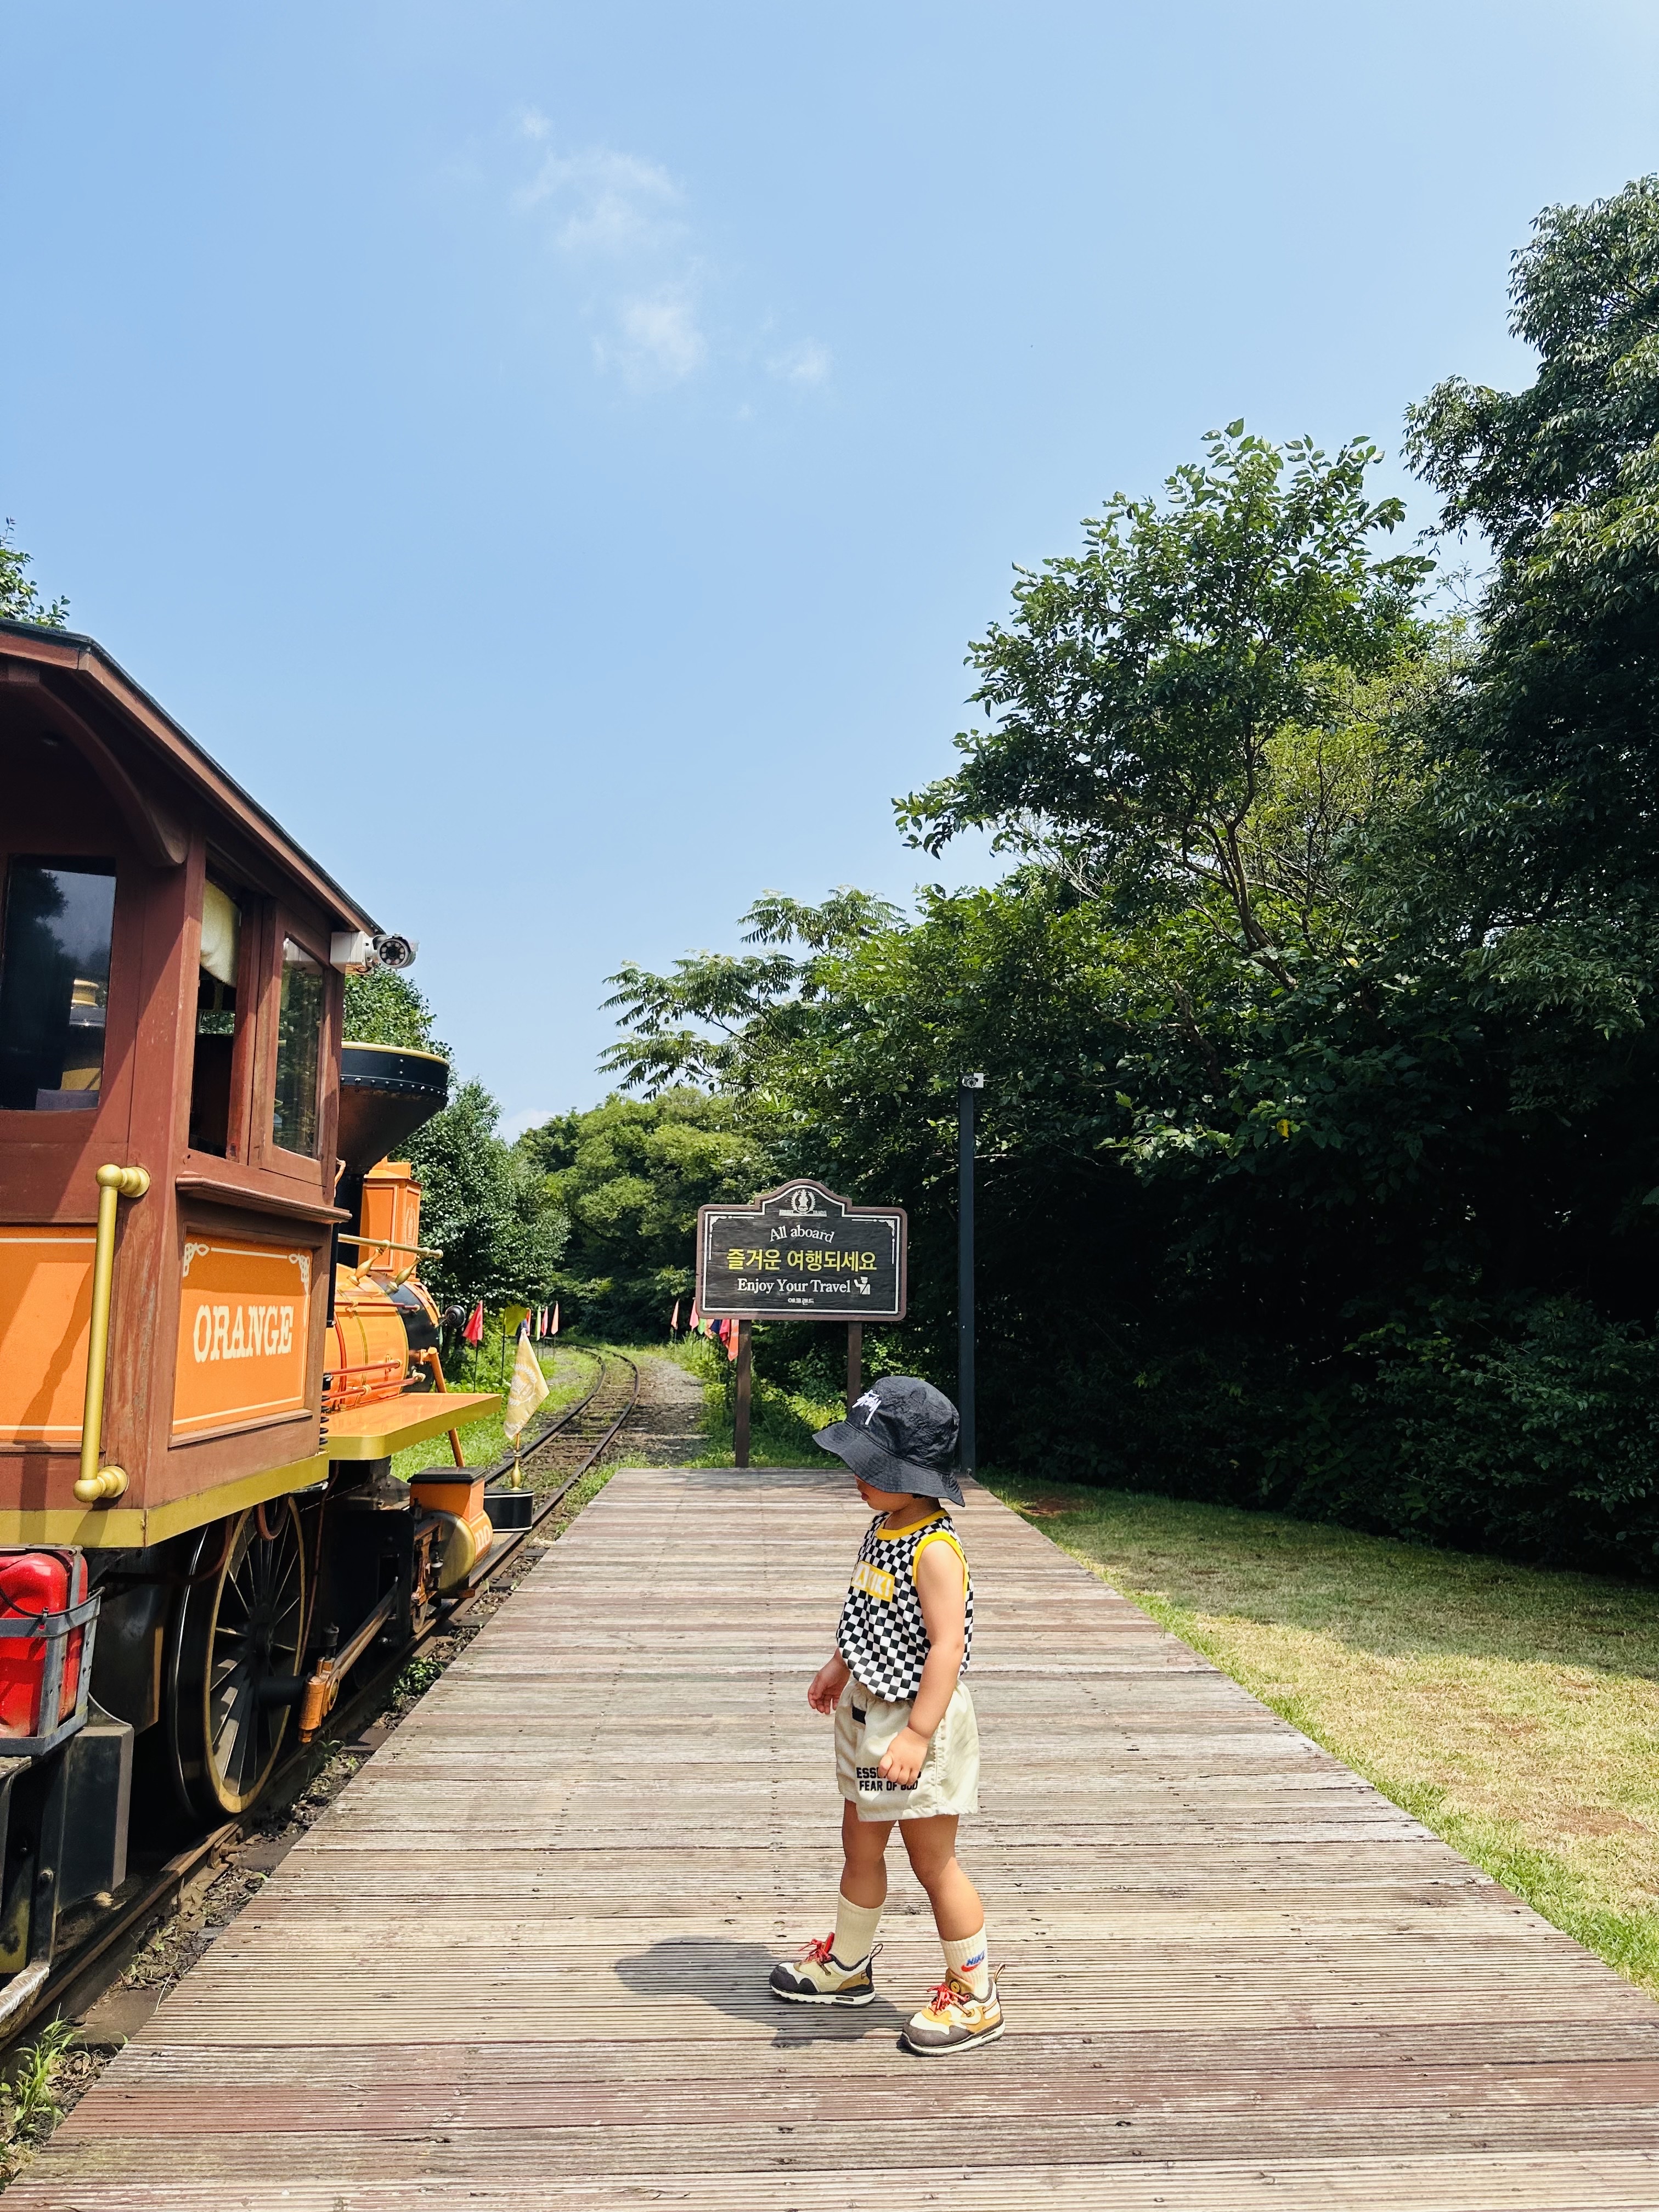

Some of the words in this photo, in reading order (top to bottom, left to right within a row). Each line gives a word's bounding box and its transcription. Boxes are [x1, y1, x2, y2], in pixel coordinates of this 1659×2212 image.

[770, 1225, 788, 1242] All
[790, 1224, 835, 1243] aboard
[726, 1249, 782, 1271] 즐거운
[787, 1249, 877, 1272] 여행되세요
[737, 1278, 775, 1294] Enjoy
[776, 1279, 809, 1293] Your
[810, 1279, 851, 1293] Travel
[193, 1305, 294, 1363] ORANGE
[859, 1780, 883, 1791] FEAR
[886, 1781, 897, 1791] OF
